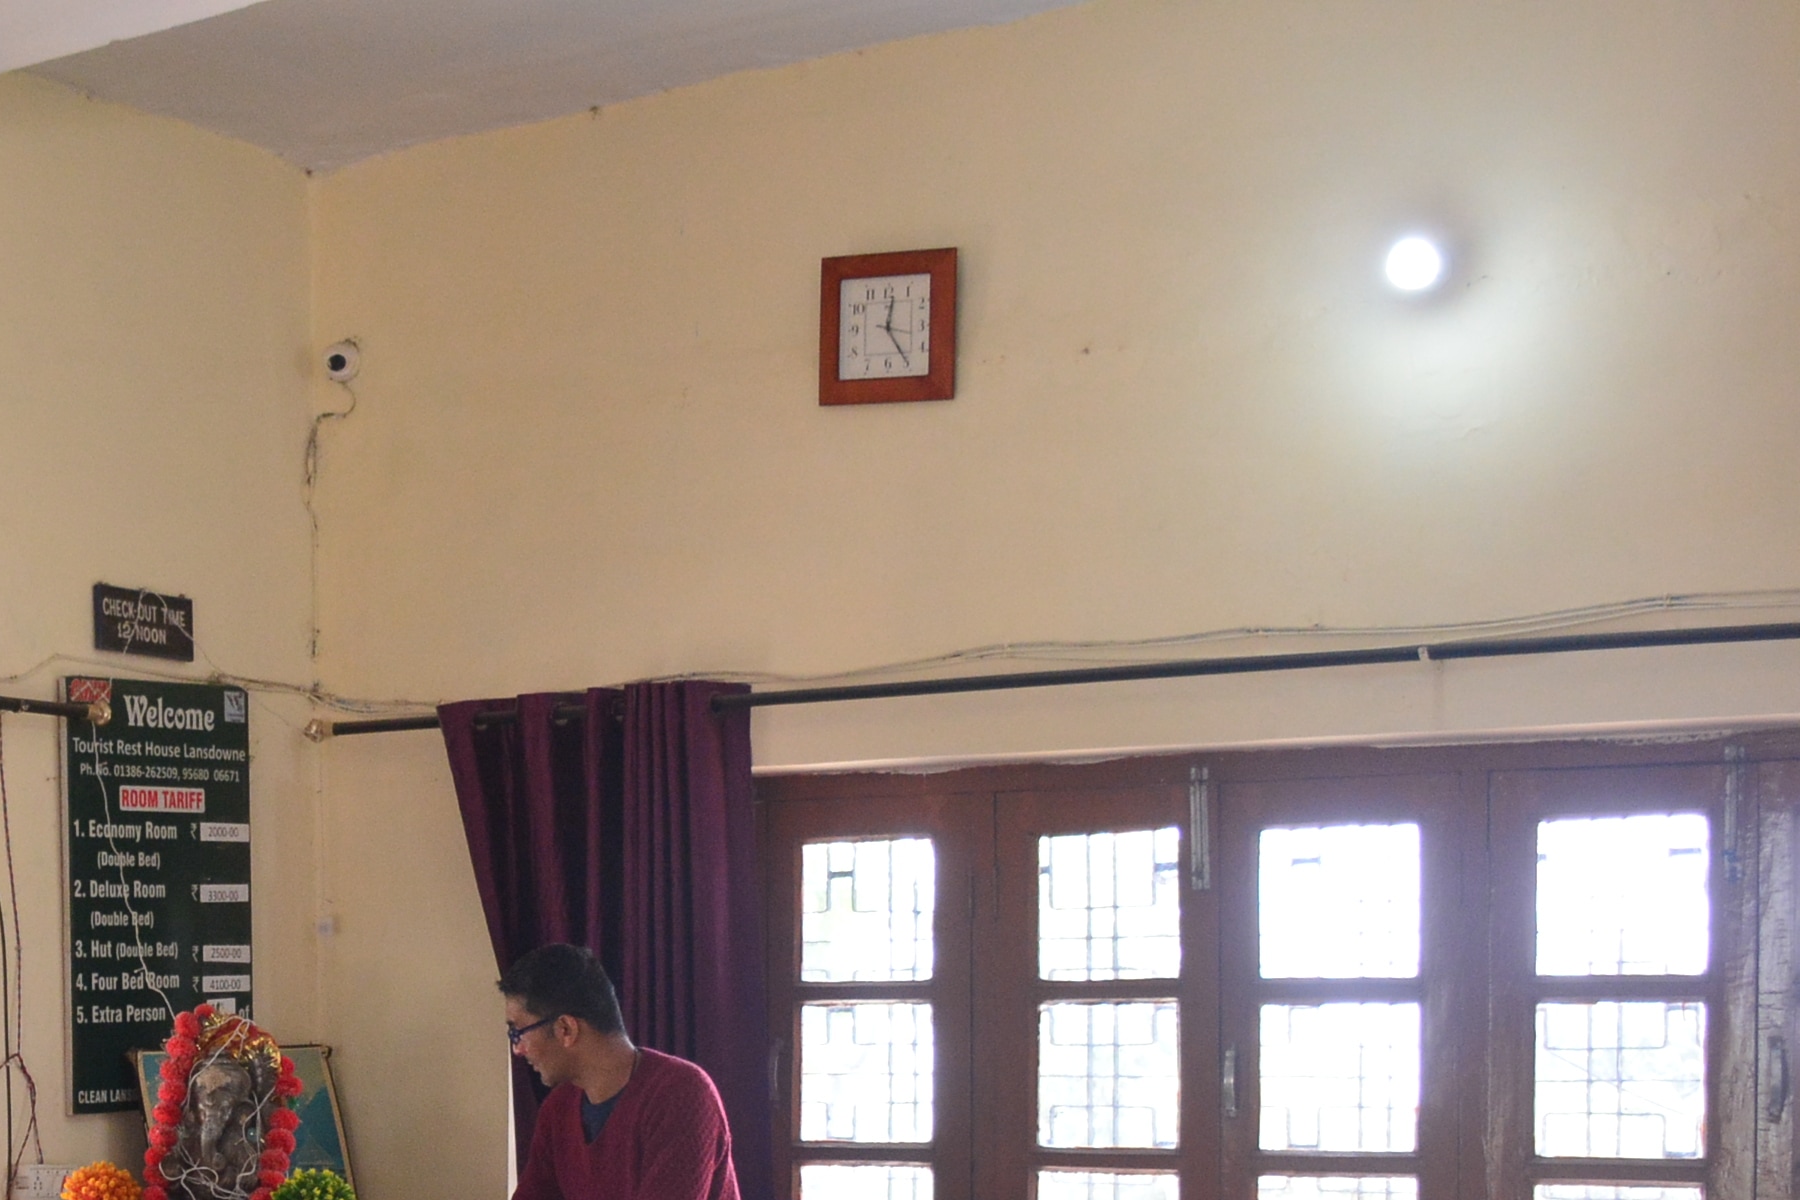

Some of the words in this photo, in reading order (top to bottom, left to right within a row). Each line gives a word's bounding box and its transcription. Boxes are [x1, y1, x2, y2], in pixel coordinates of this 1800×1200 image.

[161, 607, 186, 627] TIME
[117, 622, 132, 639] 12
[135, 626, 167, 645] NOON
[123, 694, 215, 731] Welcome
[72, 737, 114, 754] Tourist
[116, 739, 142, 757] Rest
[145, 741, 181, 758] House
[183, 743, 246, 762] Lansdowne
[121, 789, 159, 808] ROOM
[162, 791, 203, 810] TARIFF
[73, 819, 85, 837] 1.
[88, 819, 142, 843] Economy
[145, 821, 178, 840] Room
[97, 851, 135, 870] (Double
[138, 853, 161, 871] Bed)
[74, 879, 86, 898] 2.
[89, 880, 130, 899] Deluxe
[133, 881, 166, 899] Room
[90, 911, 129, 929] (Double
[132, 911, 154, 929] Bed)
[75, 939, 87, 958] 3.
[91, 940, 112, 958] Hut
[116, 943, 153, 961] (Double
[156, 942, 178, 960] Bed)
[76, 973, 87, 991] 4.
[91, 972, 117, 991] Four
[121, 972, 144, 990] Bed
[149, 972, 180, 989] Room
[76, 1006, 88, 1024] 5.
[92, 1005, 122, 1024] Extra
[126, 1004, 166, 1022] Person
[78, 1090, 107, 1104] CLEAN
